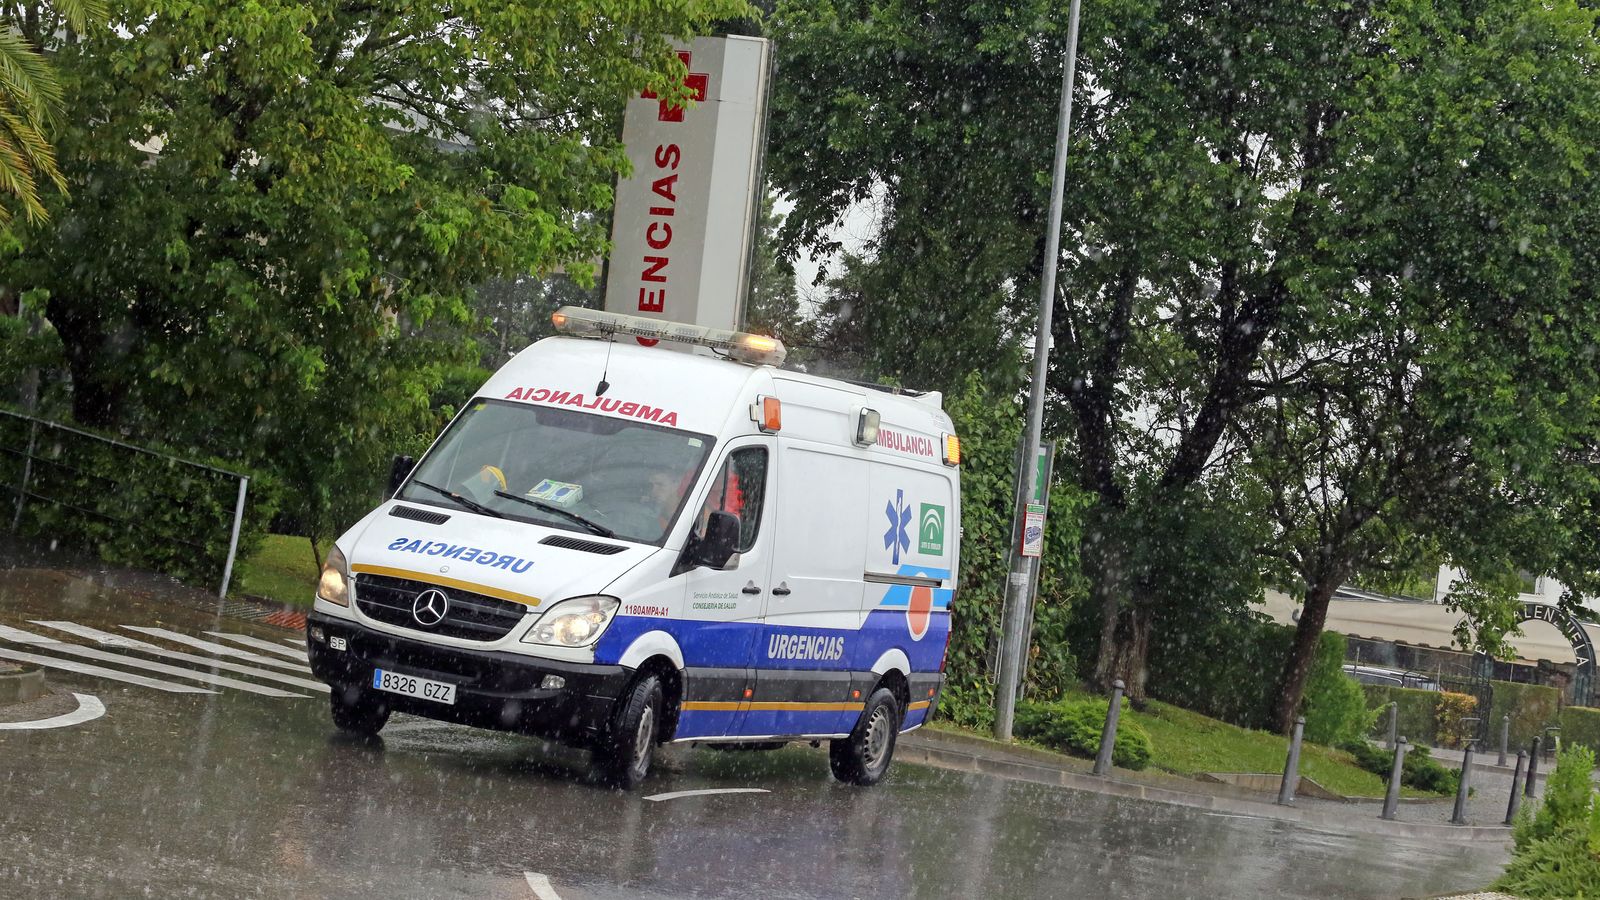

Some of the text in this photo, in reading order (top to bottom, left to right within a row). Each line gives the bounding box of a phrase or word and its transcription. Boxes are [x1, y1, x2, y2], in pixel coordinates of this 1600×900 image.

[624, 604, 669, 616] 1180AMPA-A1
[331, 636, 345, 649] SP
[767, 634, 844, 660] URGENCIAS
[1513, 605, 1589, 666] ALENUELA
[383, 673, 450, 701] 8326 GZZ
